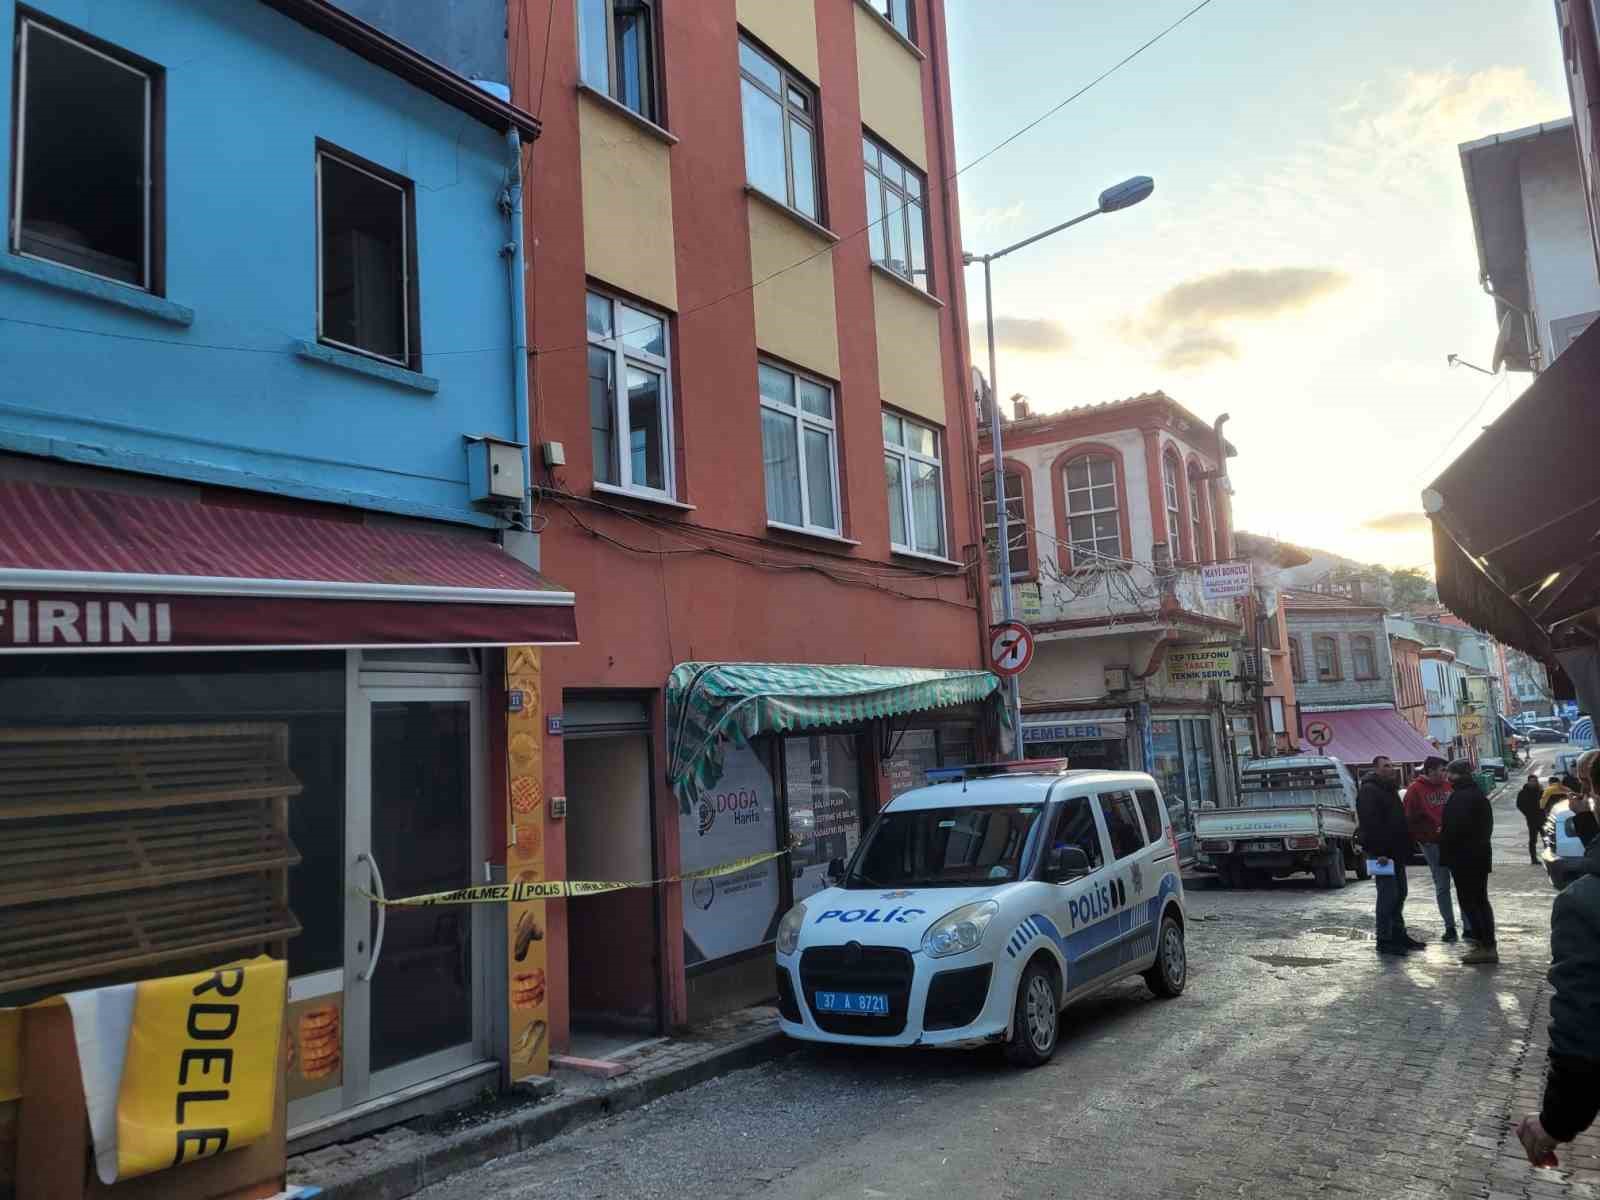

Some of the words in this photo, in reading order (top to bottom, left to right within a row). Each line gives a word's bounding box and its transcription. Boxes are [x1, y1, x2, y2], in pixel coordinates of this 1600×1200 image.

[0, 599, 173, 643] IRINI
[716, 786, 760, 813] DOĞA
[1069, 881, 1110, 929] POLİS
